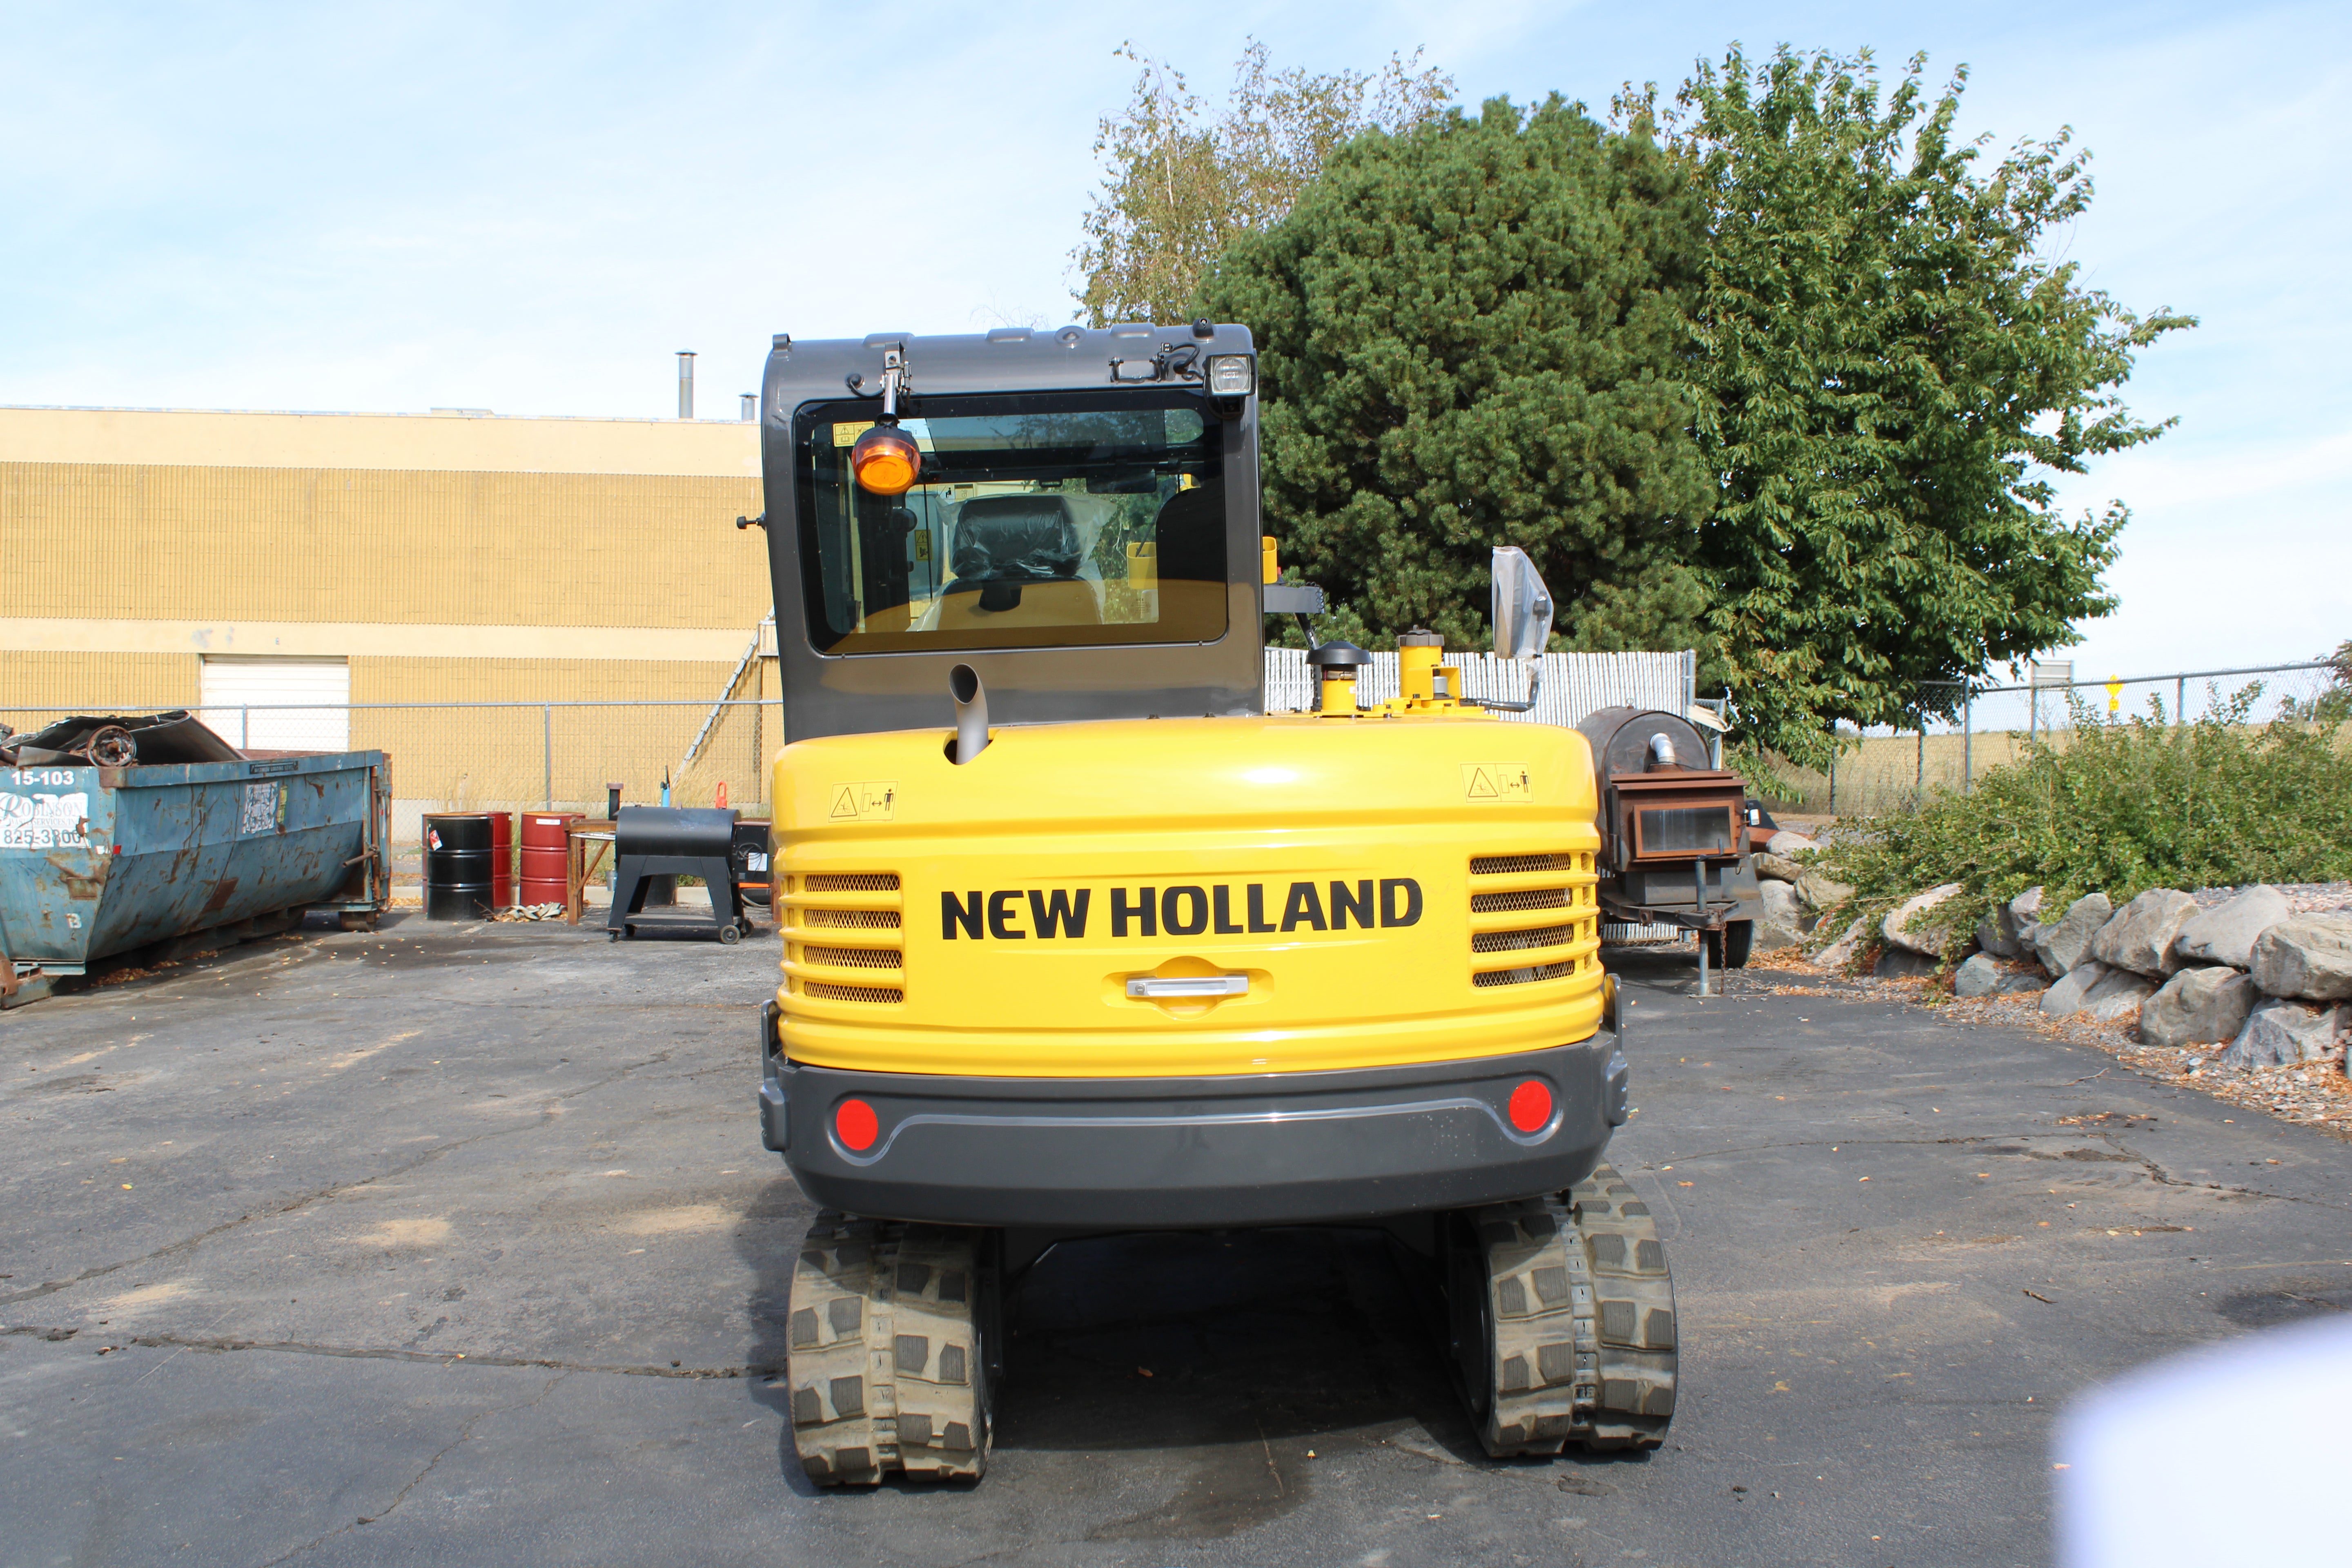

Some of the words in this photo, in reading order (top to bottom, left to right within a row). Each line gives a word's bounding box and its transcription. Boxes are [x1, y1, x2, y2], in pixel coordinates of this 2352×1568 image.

[12, 771, 75, 785] 15-103
[4, 829, 81, 844] 825-3800
[942, 889, 1090, 939] NEW
[1111, 879, 1422, 936] HOLLAND
